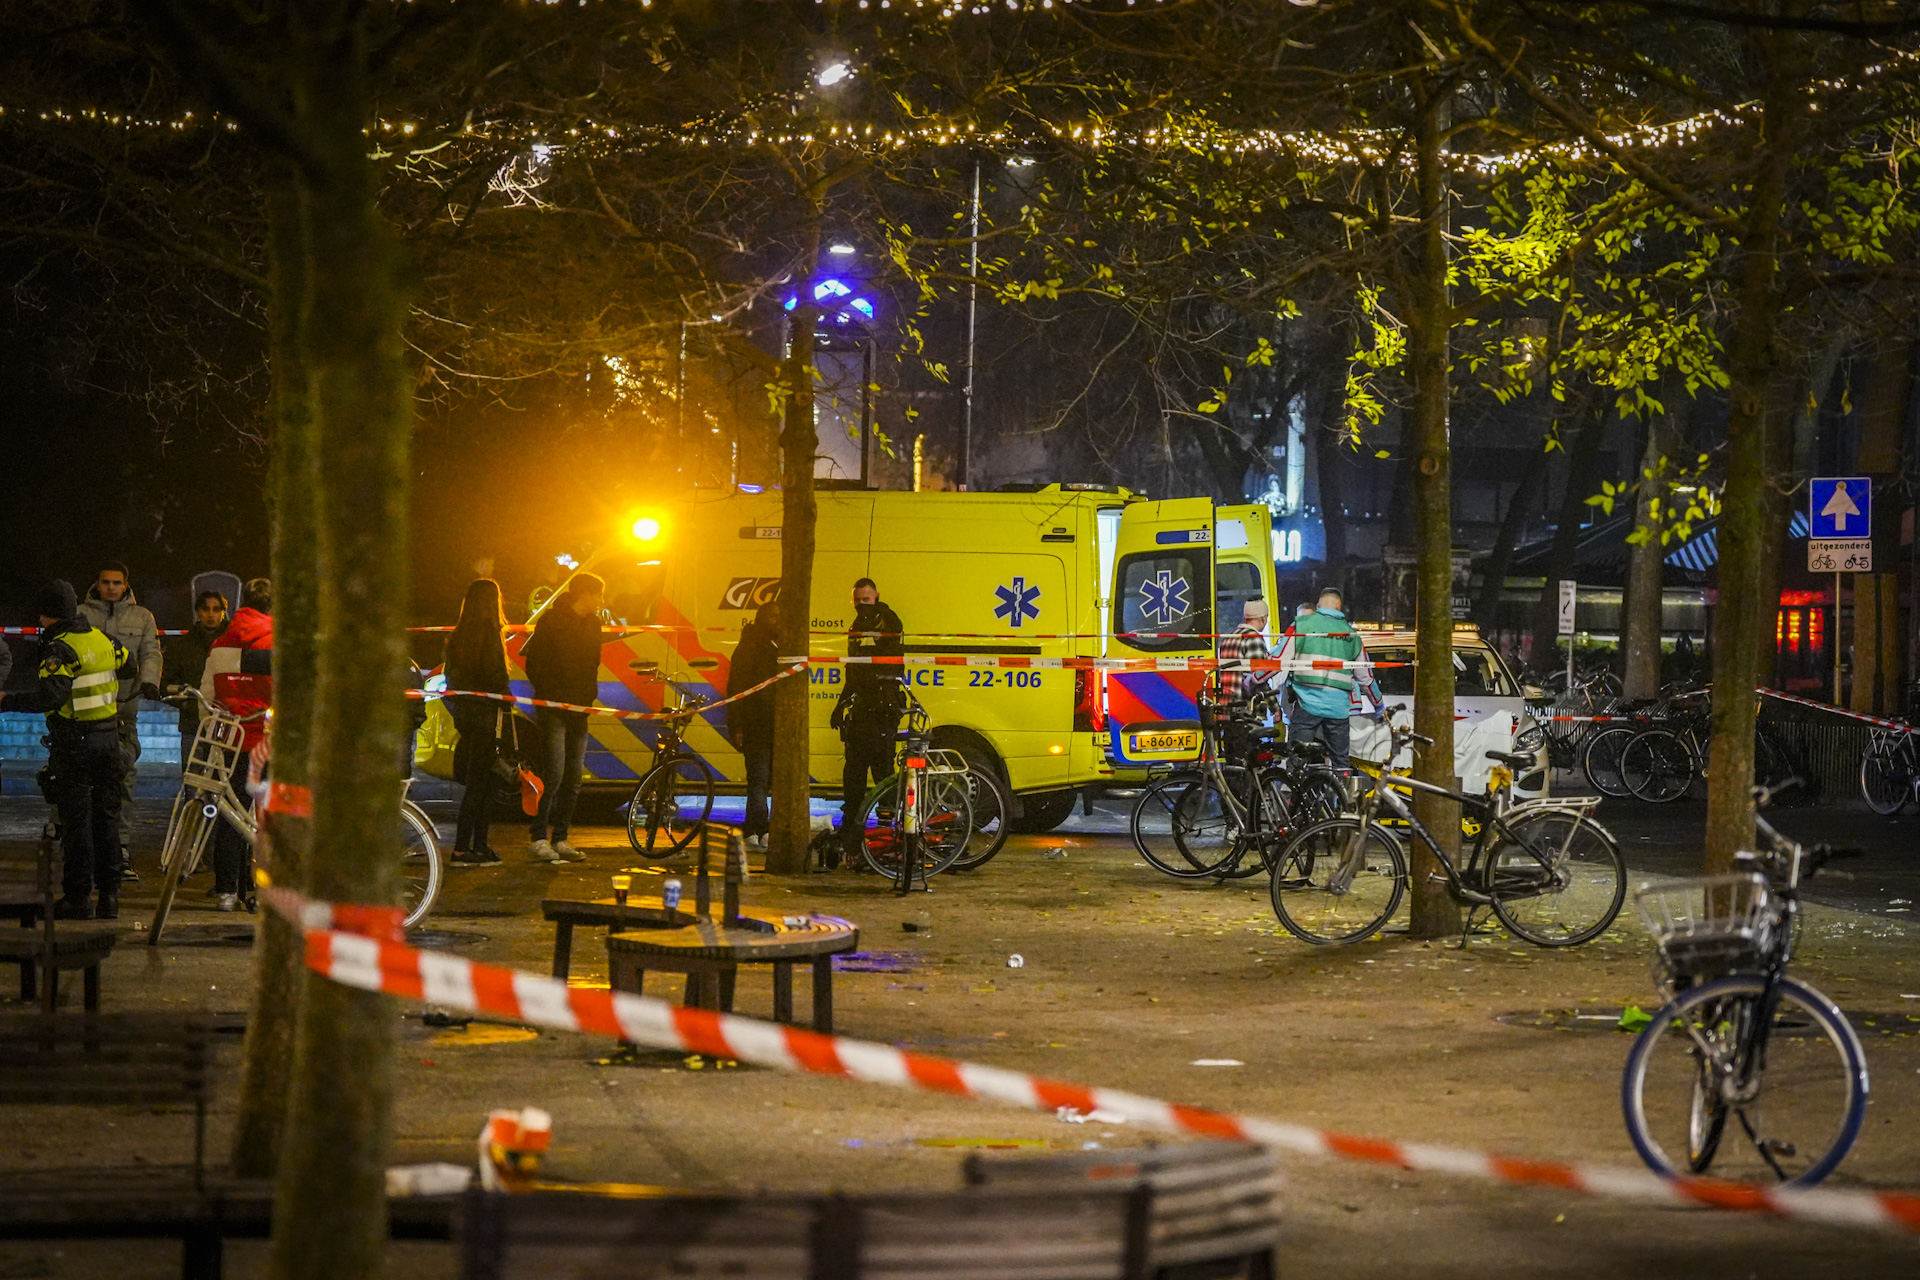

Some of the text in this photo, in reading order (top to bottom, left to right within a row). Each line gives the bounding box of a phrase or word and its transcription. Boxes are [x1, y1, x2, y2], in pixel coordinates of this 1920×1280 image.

[1811, 542, 1870, 551] uitgezonderd
[811, 618, 844, 627] doost
[969, 671, 1042, 688] 22-106
[1140, 735, 1192, 748] L-860-XF
